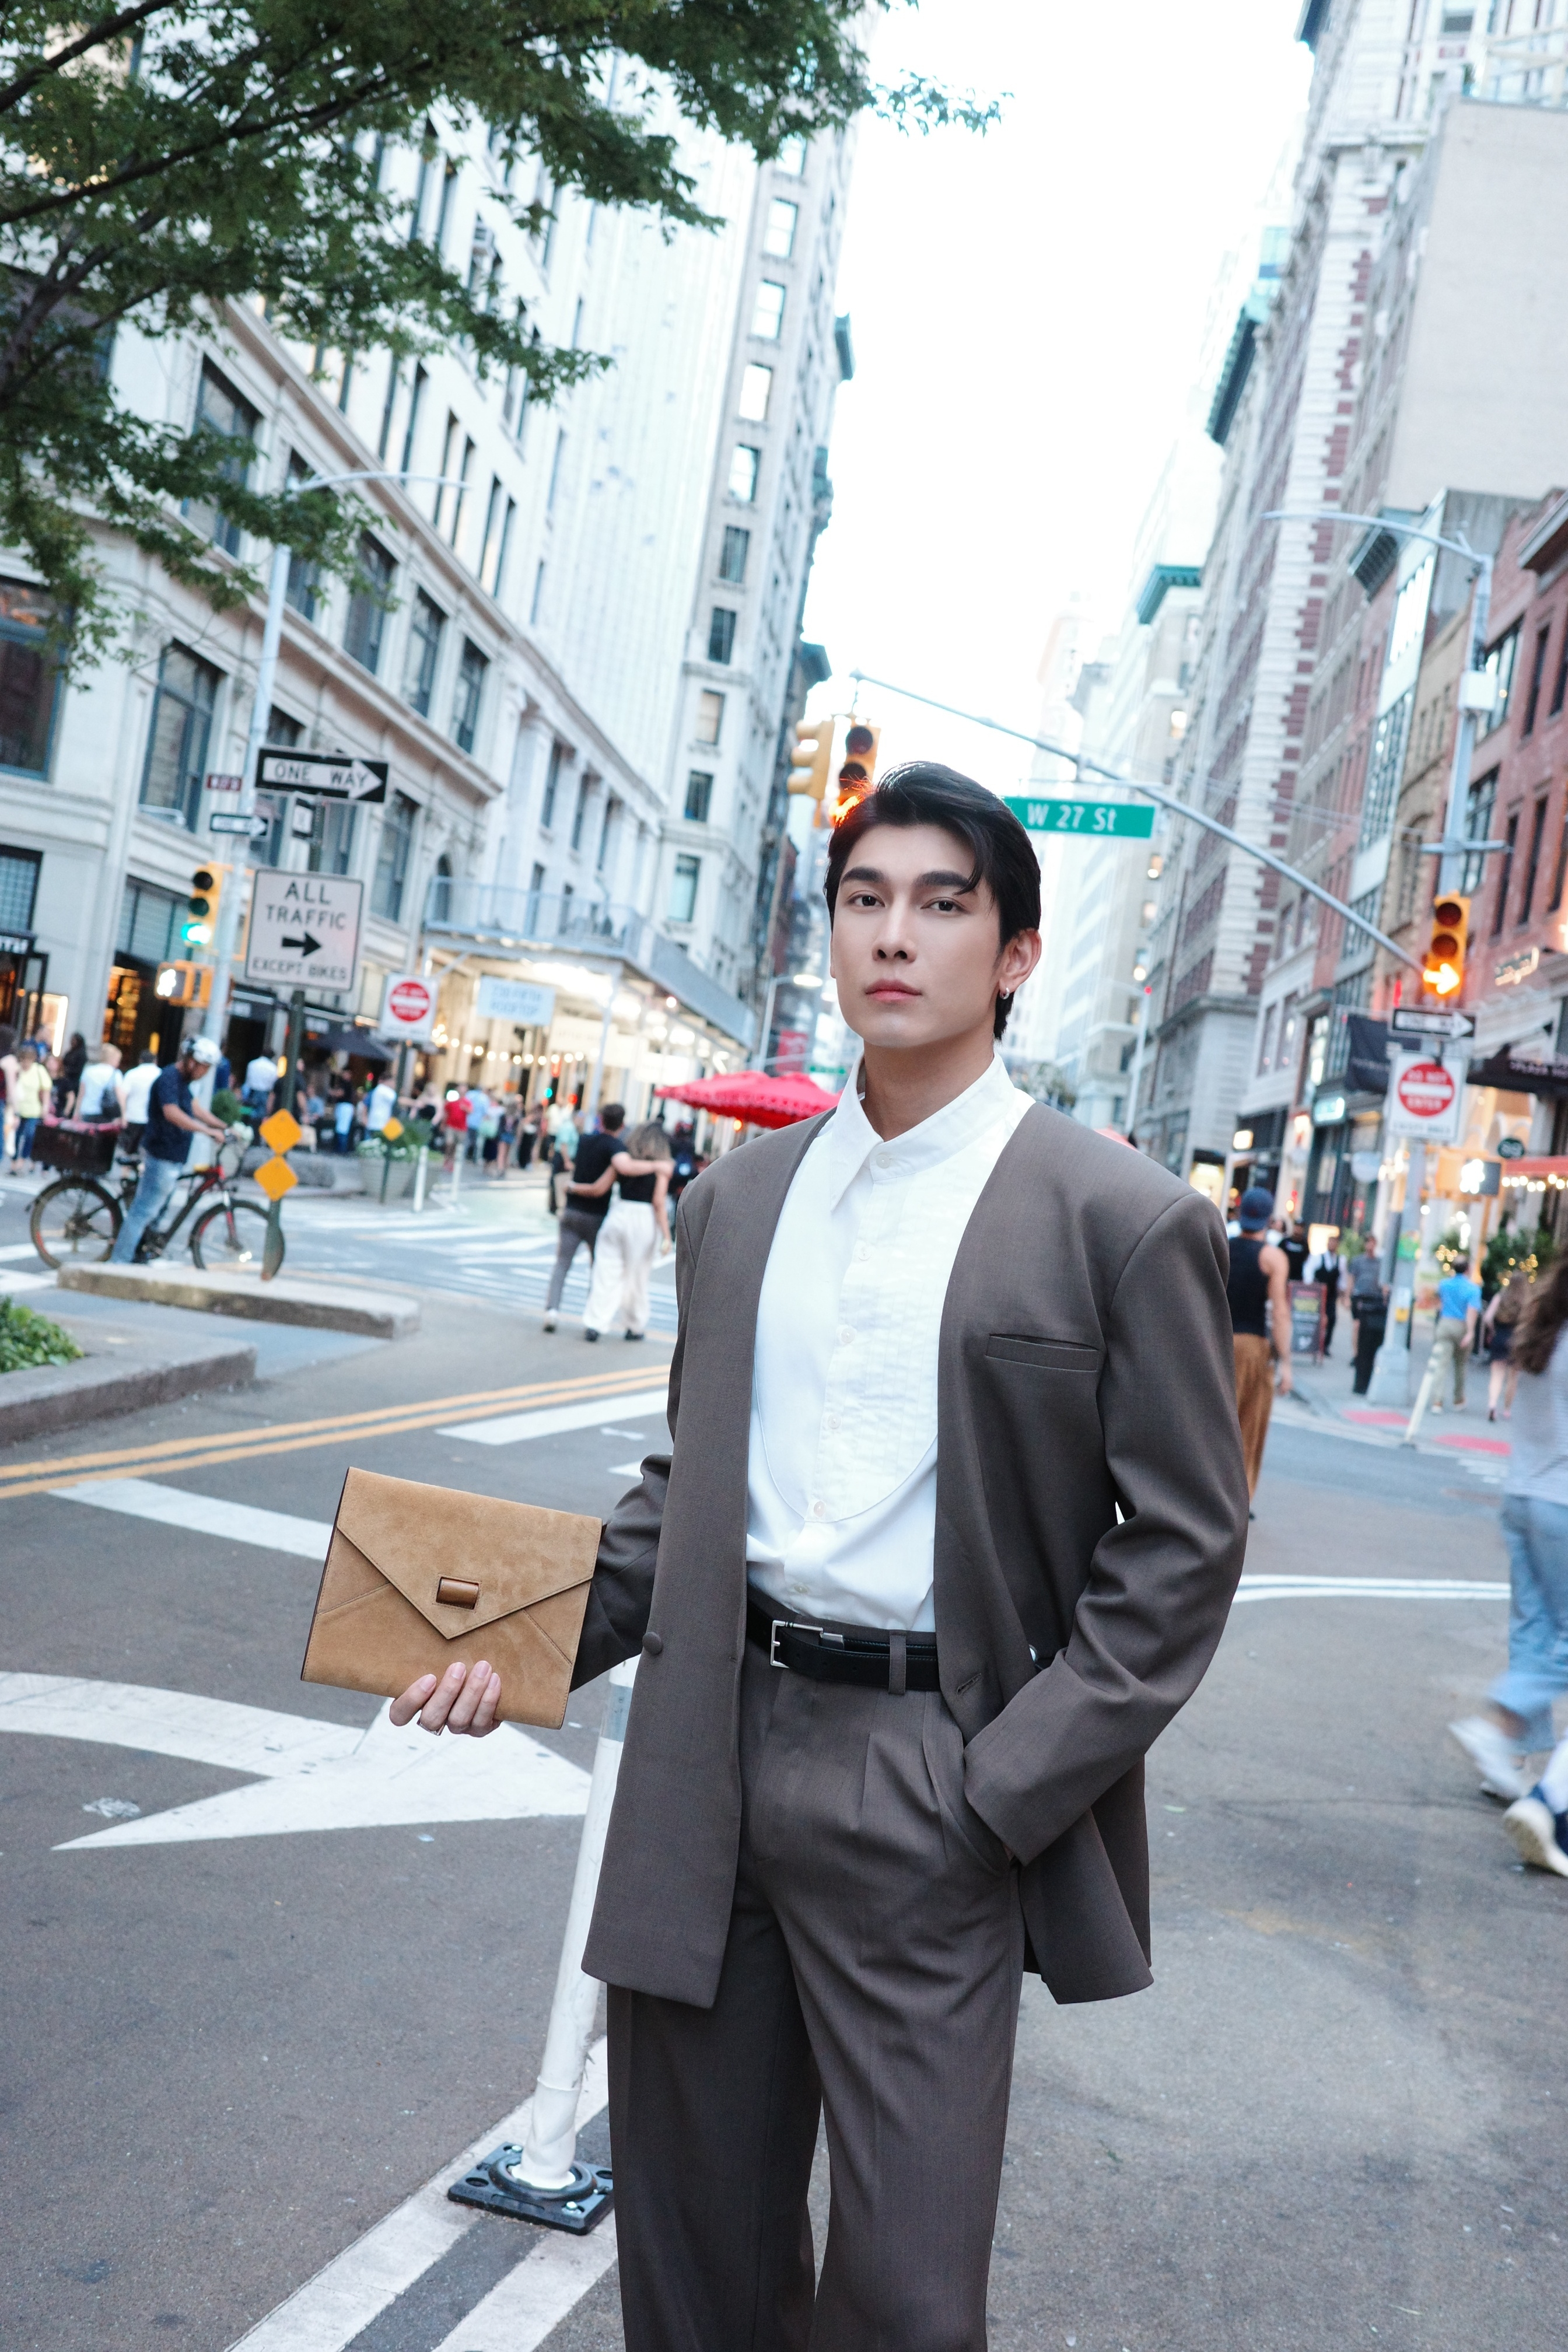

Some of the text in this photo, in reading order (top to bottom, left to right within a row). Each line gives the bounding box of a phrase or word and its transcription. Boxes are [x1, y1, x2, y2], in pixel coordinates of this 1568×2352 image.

[275, 761, 368, 788] ONE WAY
[1027, 803, 1116, 832] W 27 St
[285, 881, 331, 905] ALL
[267, 904, 346, 930] TRAFFIC
[252, 958, 347, 980] EXCEPT BIKES
